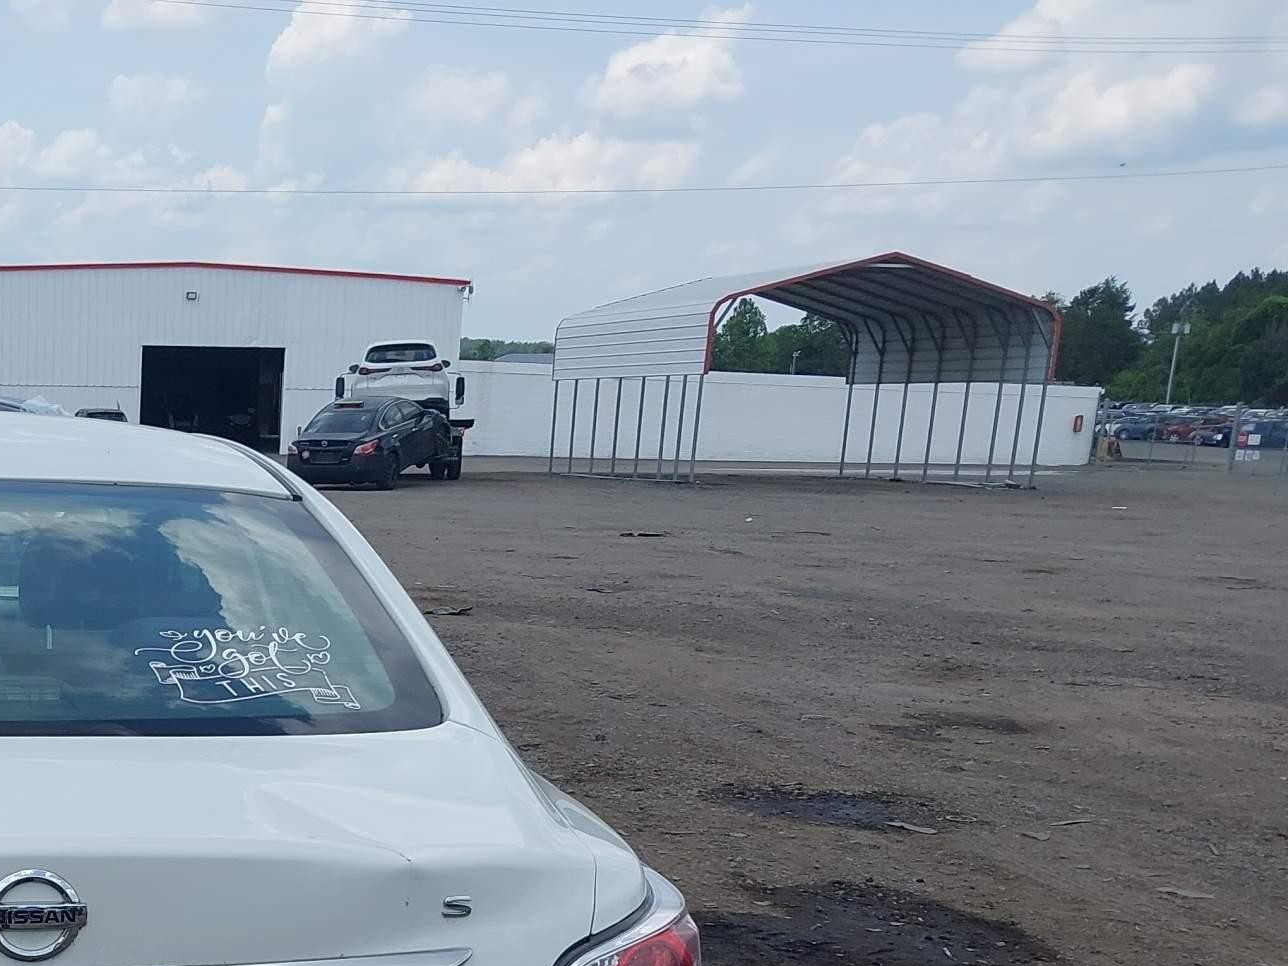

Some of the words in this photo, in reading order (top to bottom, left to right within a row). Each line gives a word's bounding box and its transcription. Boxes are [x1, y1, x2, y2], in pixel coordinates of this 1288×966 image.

[218, 641, 311, 678] got
[214, 672, 296, 697] THIS
[441, 895, 472, 918] S
